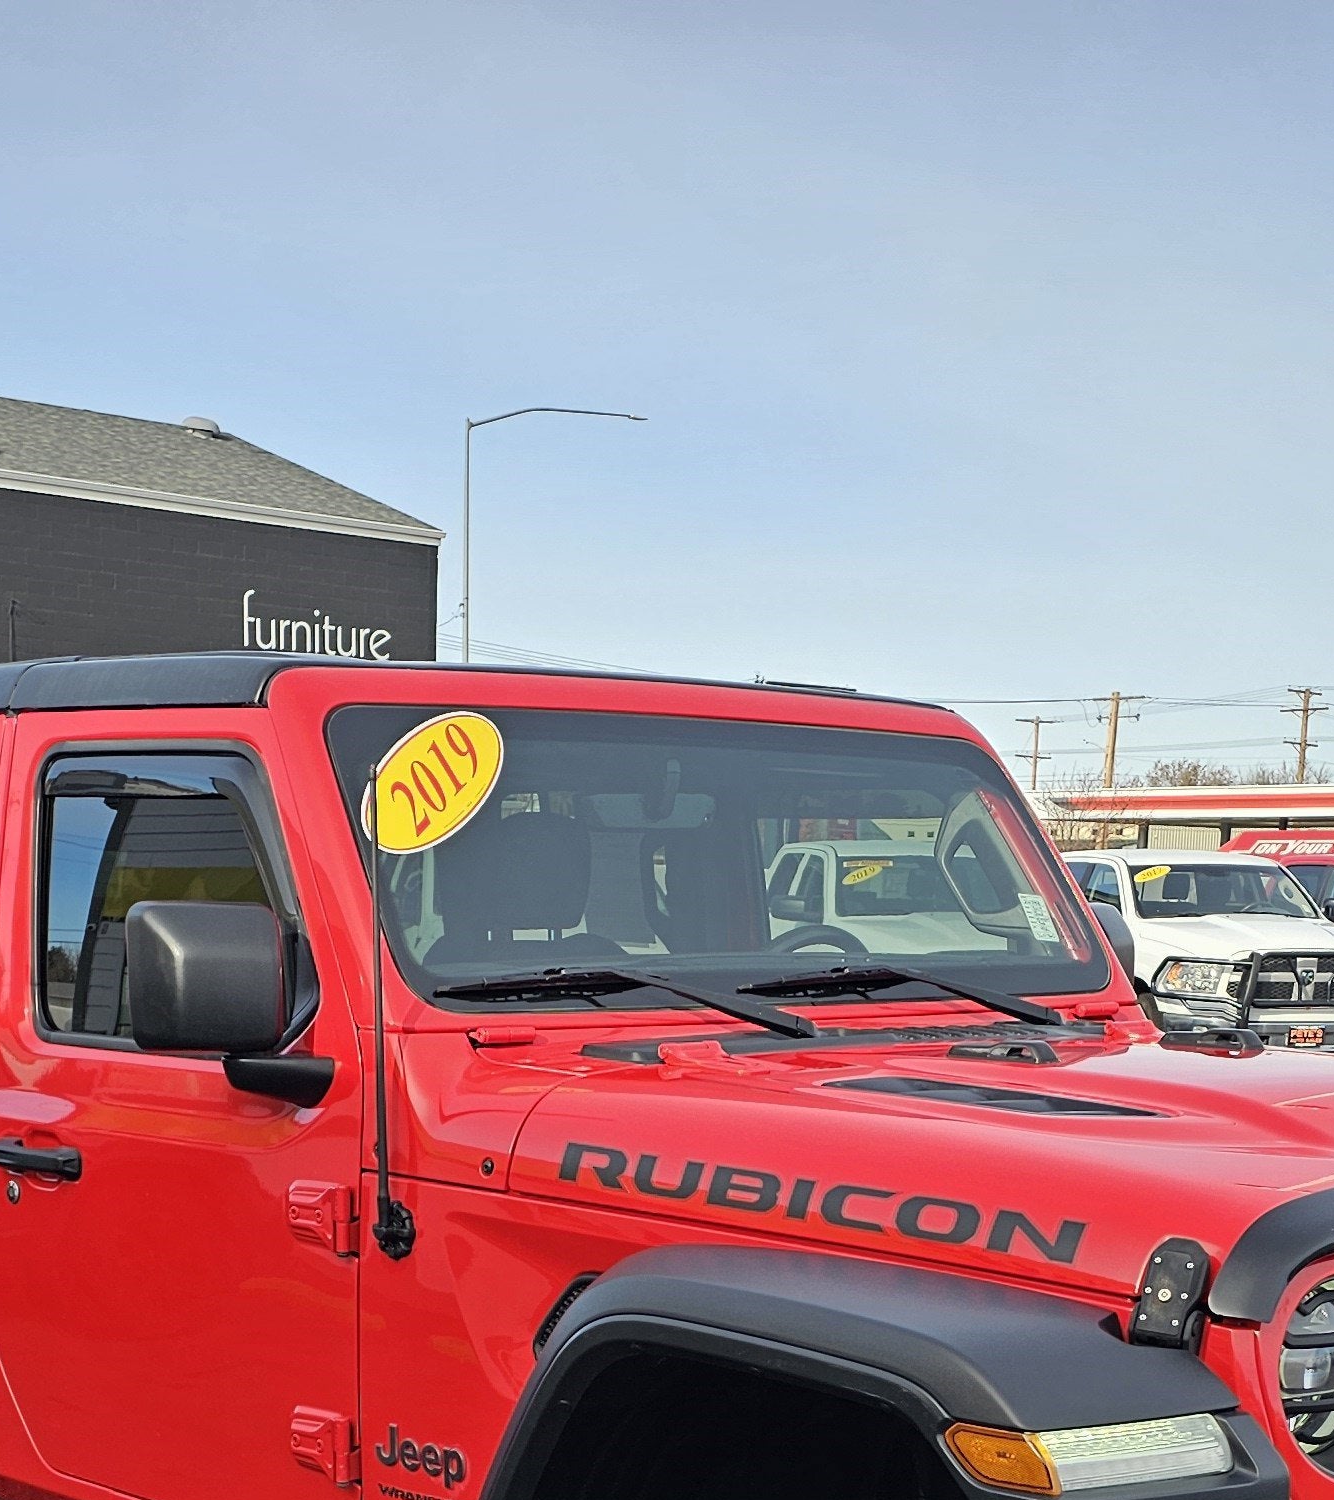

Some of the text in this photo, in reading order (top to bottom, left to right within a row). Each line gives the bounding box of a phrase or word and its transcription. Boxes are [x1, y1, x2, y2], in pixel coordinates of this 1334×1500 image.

[243, 589, 391, 660] furniture
[390, 723, 478, 837] 2019
[851, 866, 876, 882] 2019
[558, 1141, 1088, 1264] RUBICON
[375, 1423, 466, 1489] Jeep
